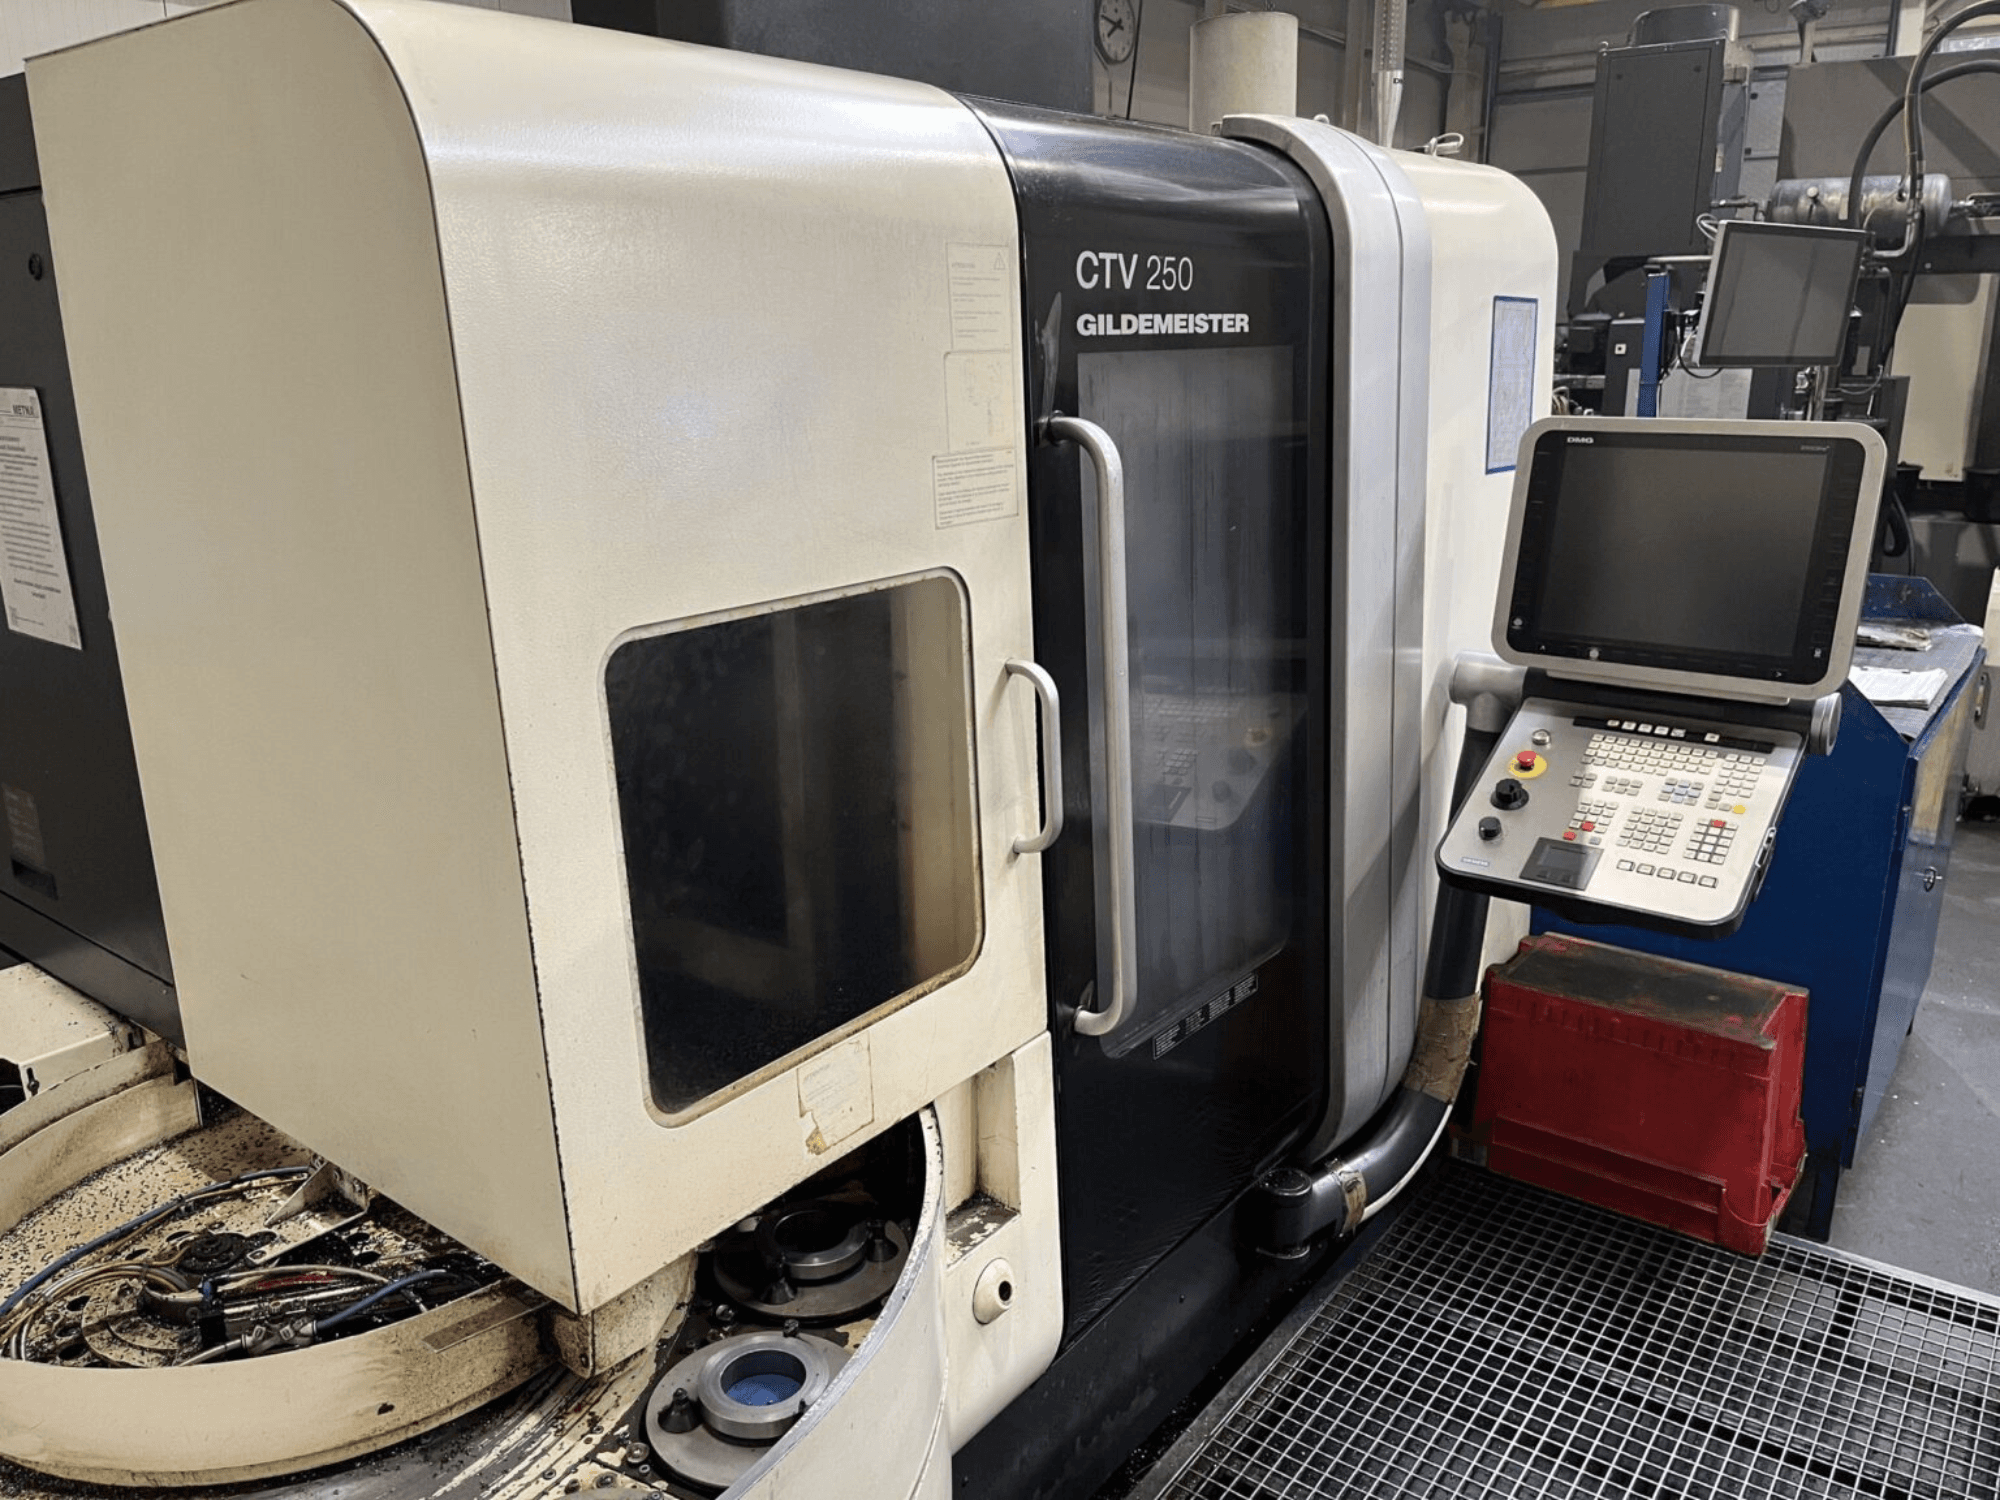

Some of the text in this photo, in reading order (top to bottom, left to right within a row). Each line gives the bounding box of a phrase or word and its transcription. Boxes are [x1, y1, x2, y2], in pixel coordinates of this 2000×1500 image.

[1076, 250, 1194, 291] CTV 250
[1076, 313, 1250, 337] GILDEMEISTER
